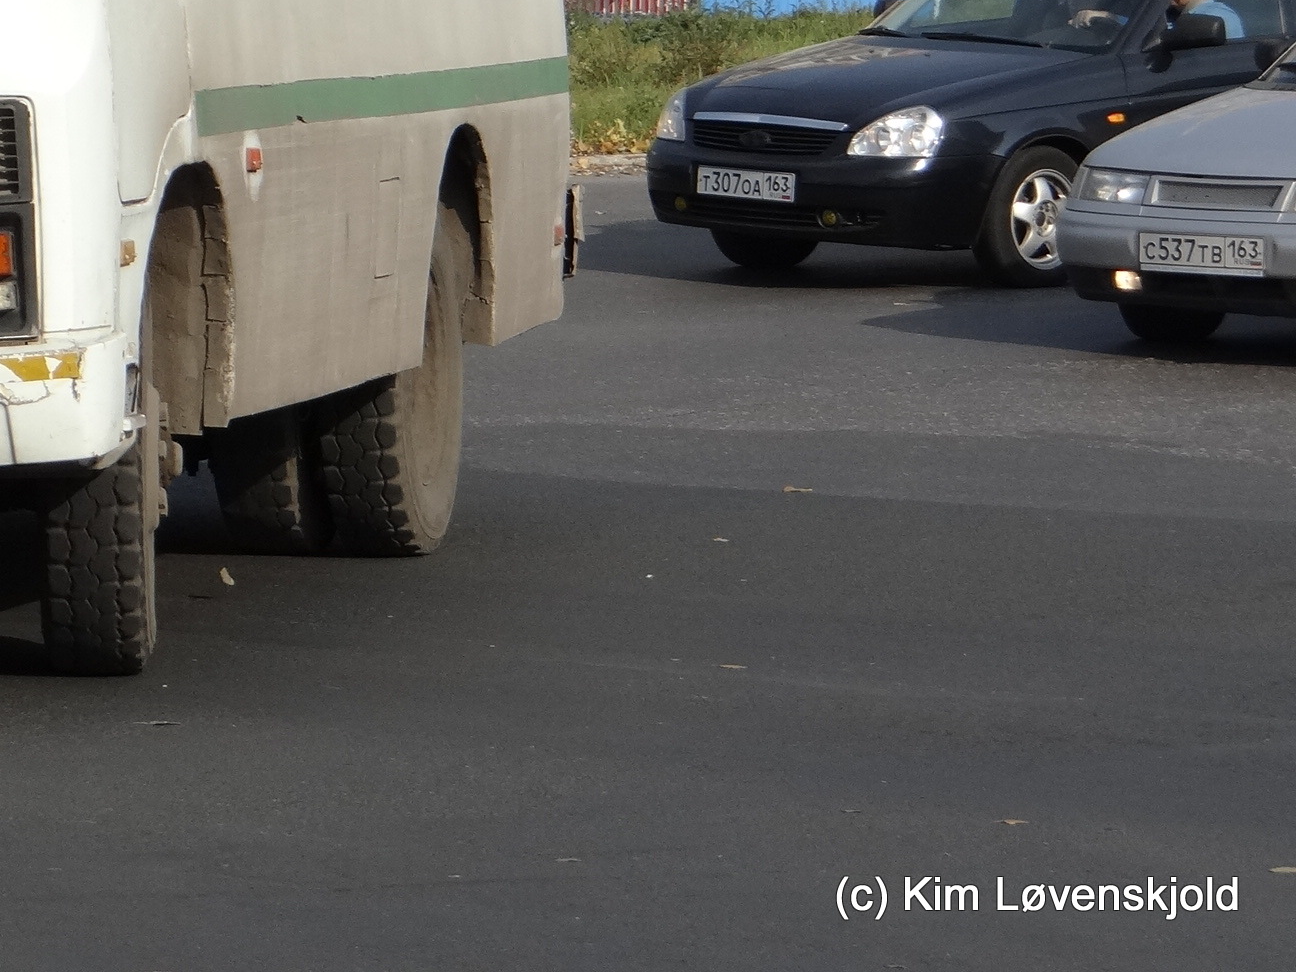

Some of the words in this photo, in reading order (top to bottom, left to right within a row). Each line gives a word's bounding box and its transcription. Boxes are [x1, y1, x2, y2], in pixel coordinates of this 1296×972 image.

[702, 171, 762, 197] Т307ОА
[765, 175, 791, 193] 163
[1144, 237, 1223, 264] С537ТВ
[1227, 239, 1259, 259] 163
